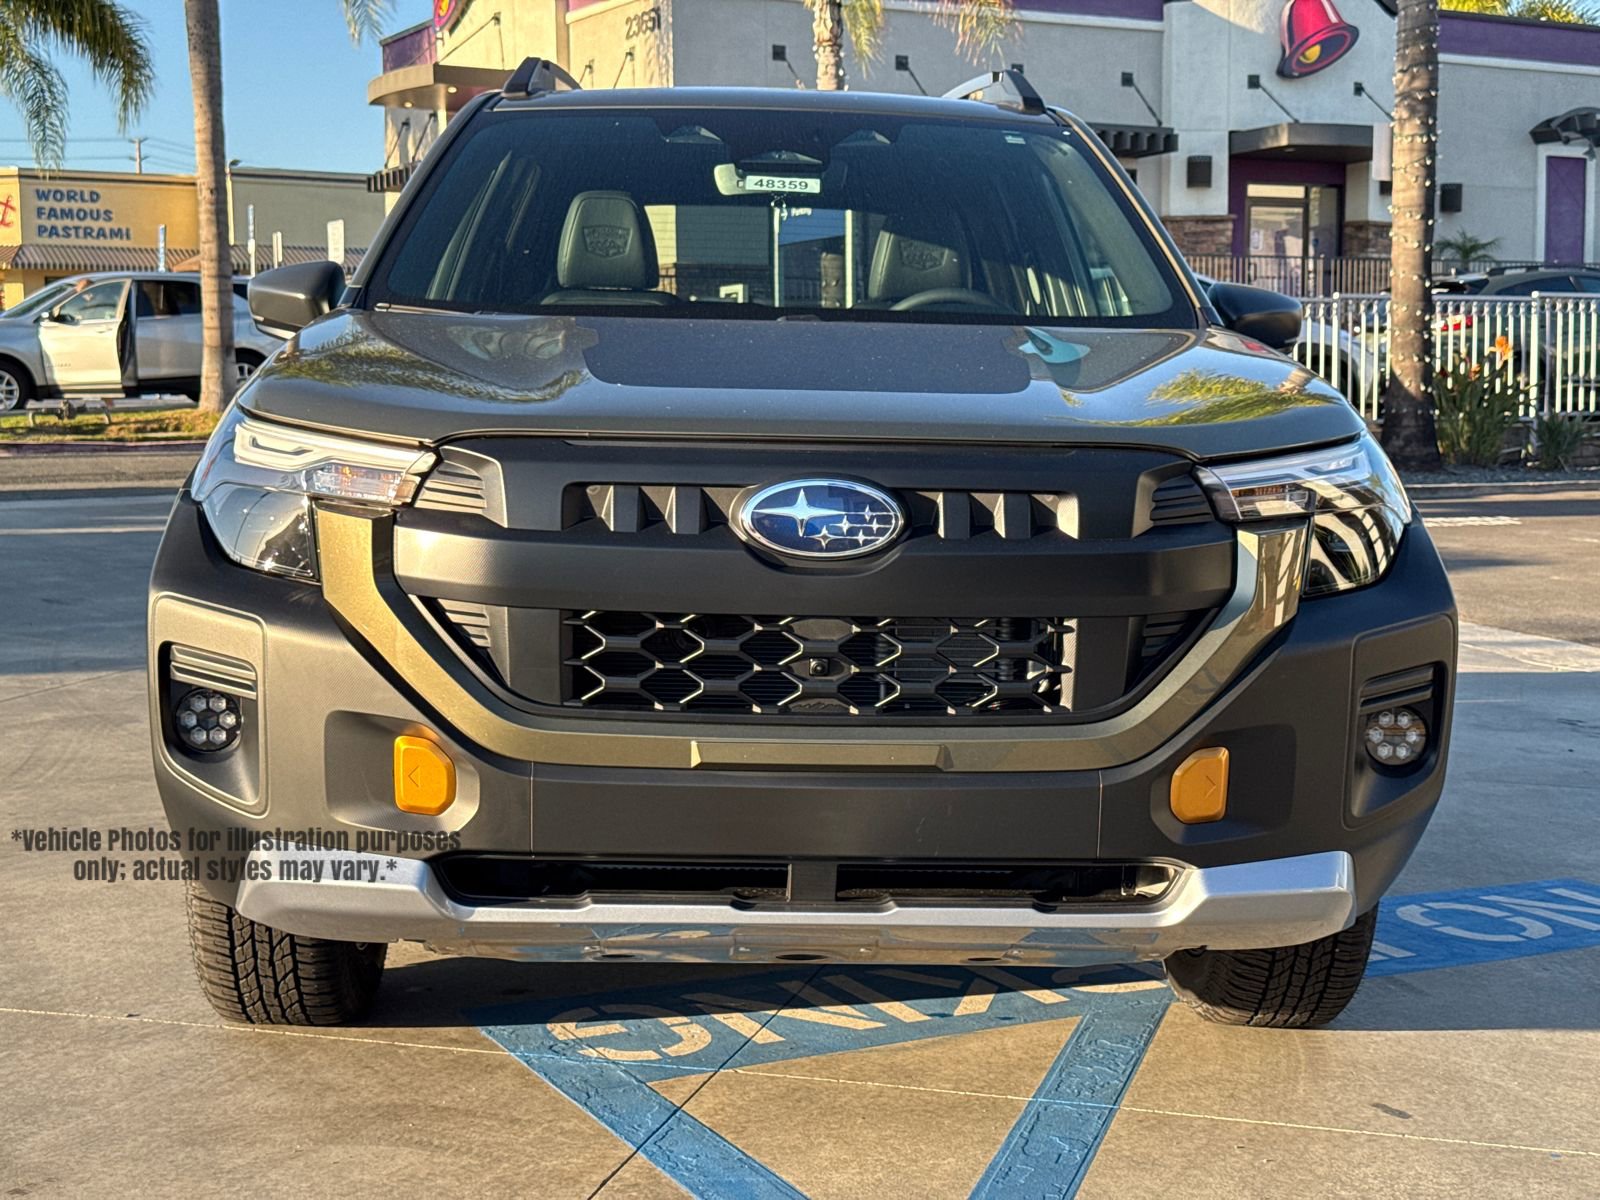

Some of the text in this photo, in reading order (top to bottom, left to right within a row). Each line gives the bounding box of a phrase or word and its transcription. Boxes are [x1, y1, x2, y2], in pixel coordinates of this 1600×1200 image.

[754, 179, 809, 190] 48359
[36, 189, 101, 203] WORLD
[37, 207, 113, 222] FAMOUS
[37, 225, 131, 240] PASTRAMI
